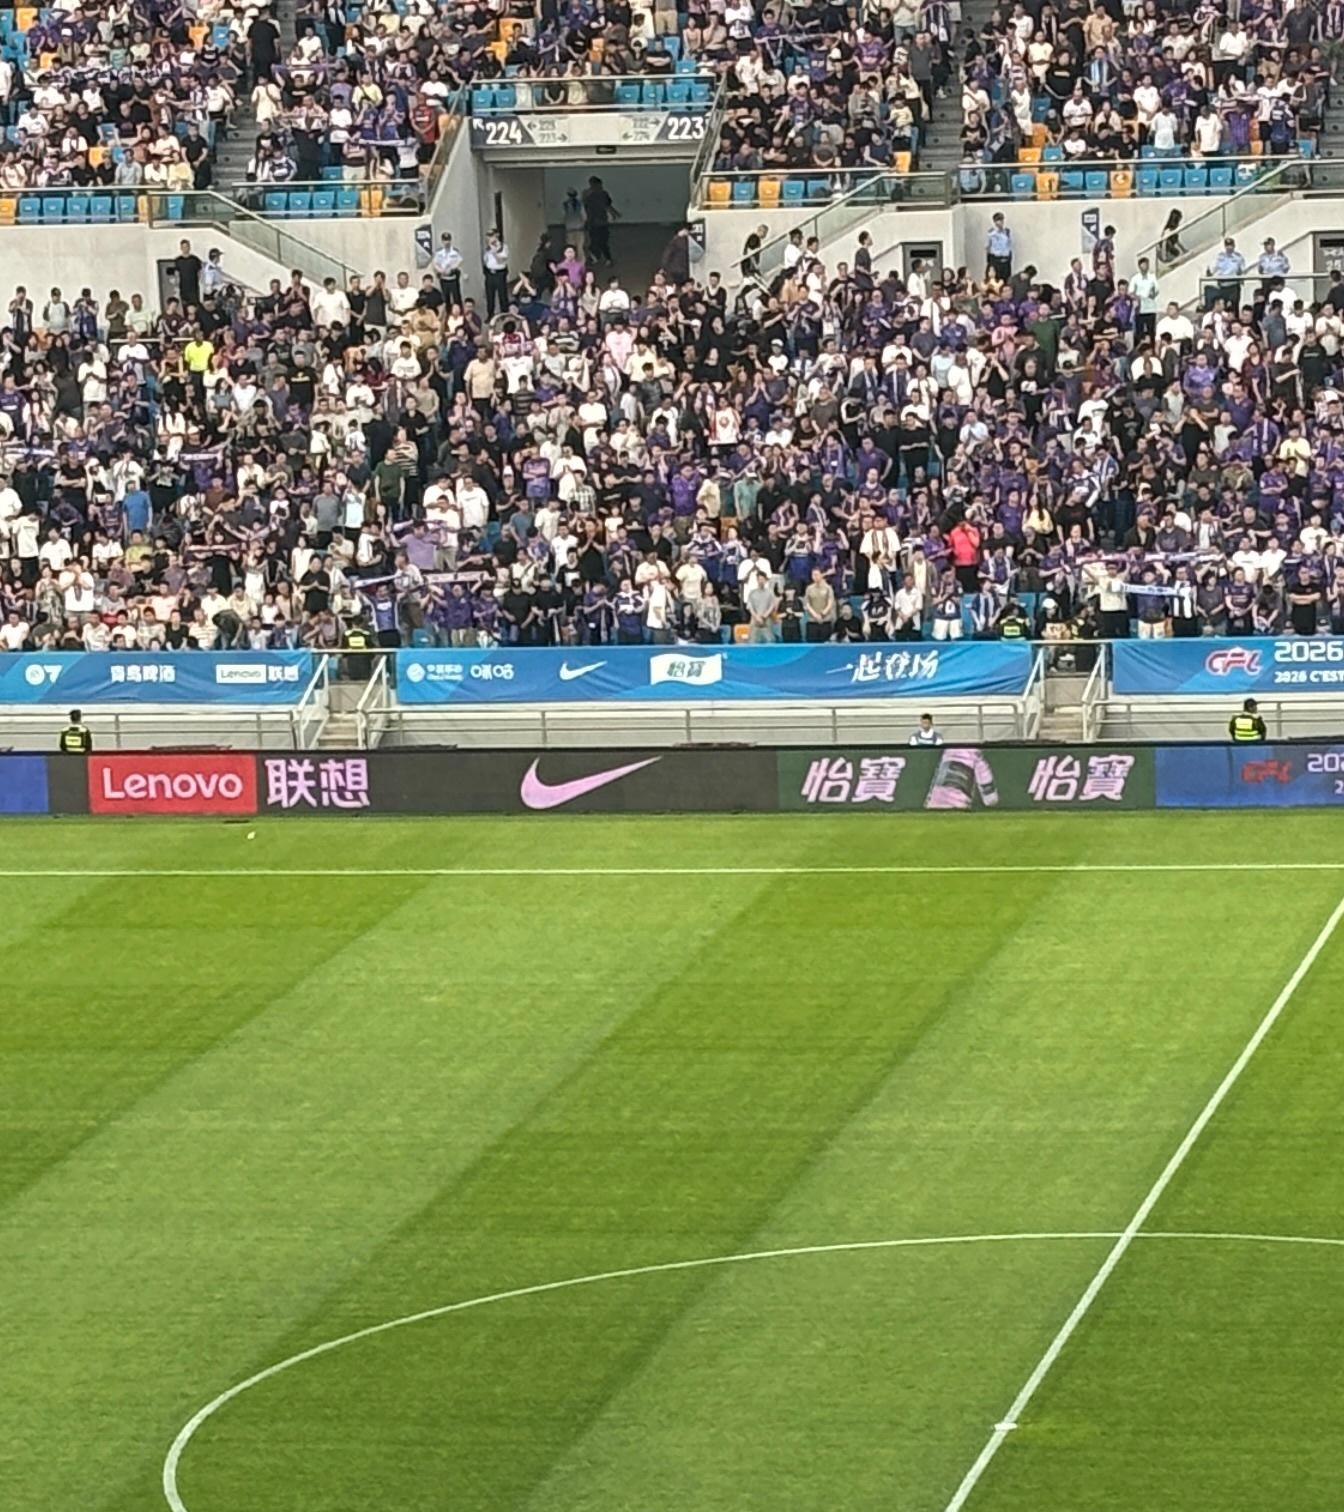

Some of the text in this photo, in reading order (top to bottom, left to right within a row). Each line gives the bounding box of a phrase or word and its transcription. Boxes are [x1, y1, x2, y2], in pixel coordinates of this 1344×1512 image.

[485, 121, 523, 144] 224
[667, 116, 704, 140] 223
[1274, 641, 1344, 662] 2026
[102, 758, 370, 809] Lenovo 联想
